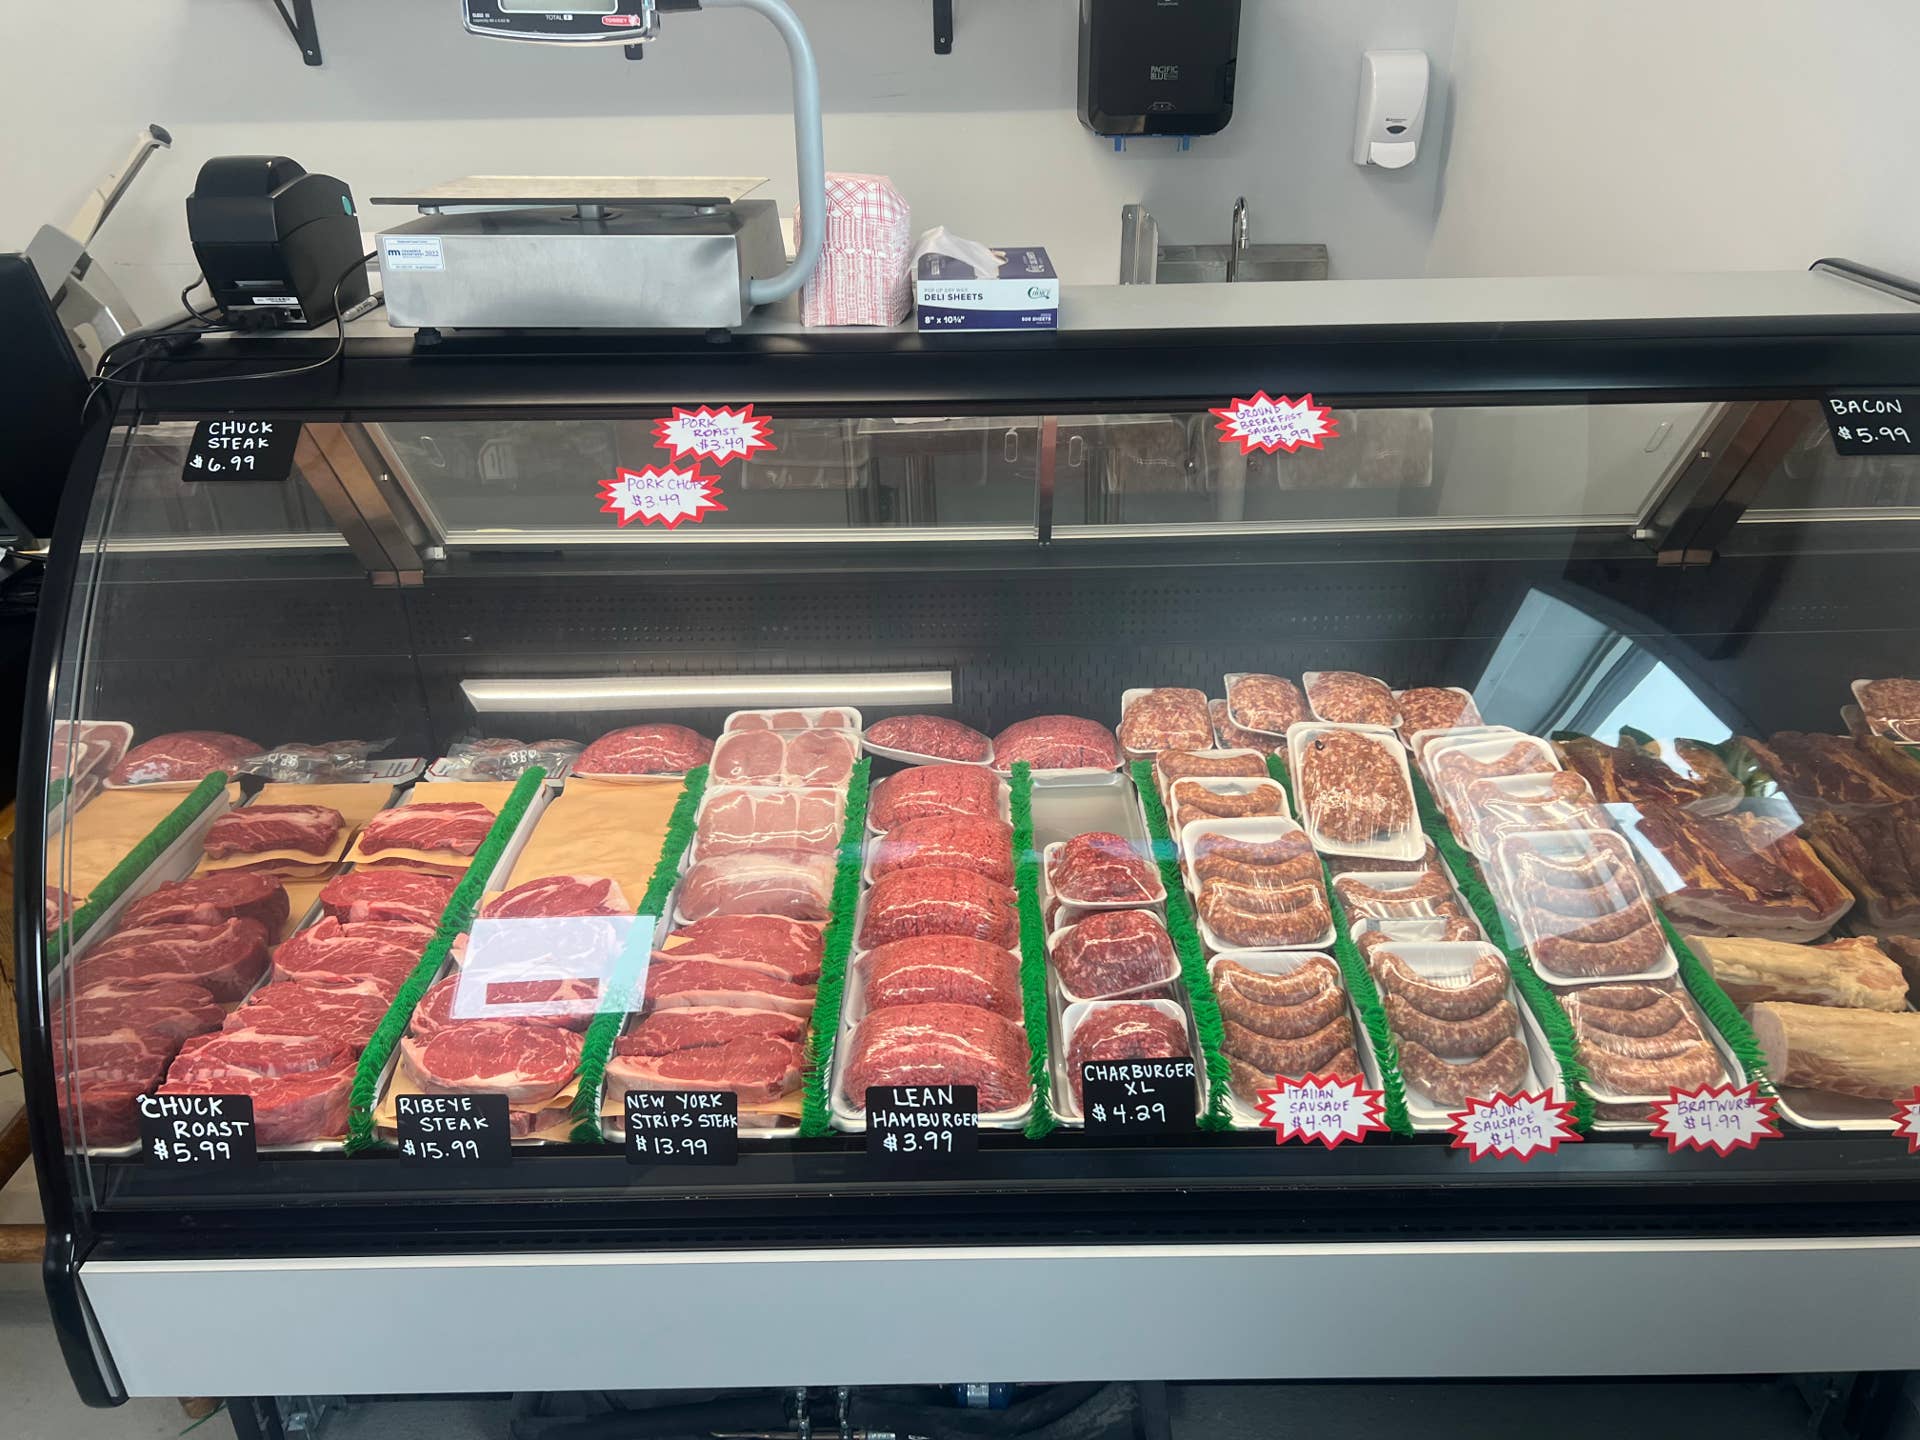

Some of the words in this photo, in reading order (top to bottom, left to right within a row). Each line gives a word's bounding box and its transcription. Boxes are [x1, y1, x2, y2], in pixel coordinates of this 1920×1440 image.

[1150, 65, 1179, 73] PACIFIC
[924, 293, 945, 301] DELI
[948, 293, 983, 301] SHEETS
[1235, 406, 1281, 420] GROUND
[1829, 399, 1902, 415] BACON
[208, 420, 273, 435] CHUCK
[681, 418, 717, 429] PORK
[1239, 412, 1303, 430] BREAKFAST
[693, 427, 738, 438] ROAST
[1247, 423, 1294, 436] SAUSAGE
[1837, 426, 1911, 444] $5.99
[208, 437, 269, 450] STEAK
[696, 437, 744, 451] $3.49
[189, 454, 255, 472] $6.99
[627, 478, 664, 491] PORK
[632, 494, 681, 509] $3.49
[1084, 1063, 1195, 1081] CHARBURGER
[893, 1084, 953, 1107] LEAN
[1124, 1081, 1155, 1096] XL
[136, 1094, 223, 1118] CHUCK
[399, 1097, 472, 1114] RIBEYE
[626, 1094, 664, 1109] NEW
[675, 1093, 723, 1109] YORK
[1289, 1100, 1350, 1114] SAUSAGE
[872, 1109, 978, 1128] HAMBURGER
[1092, 1103, 1166, 1124] $4.29
[1480, 1104, 1523, 1118] CAJUN
[420, 1117, 489, 1132] STEAK
[698, 1113, 738, 1128] STEAK
[1291, 1114, 1342, 1130] $4.99
[1473, 1114, 1535, 1133] SAUSAGE
[1684, 1115, 1741, 1131] $4.99
[173, 1120, 249, 1139] ROAST
[1489, 1126, 1543, 1146] $4.99
[402, 1139, 480, 1159] $15.99
[635, 1134, 708, 1155] $13.99
[883, 1130, 953, 1152] $3.99
[153, 1138, 231, 1162] $5.99
